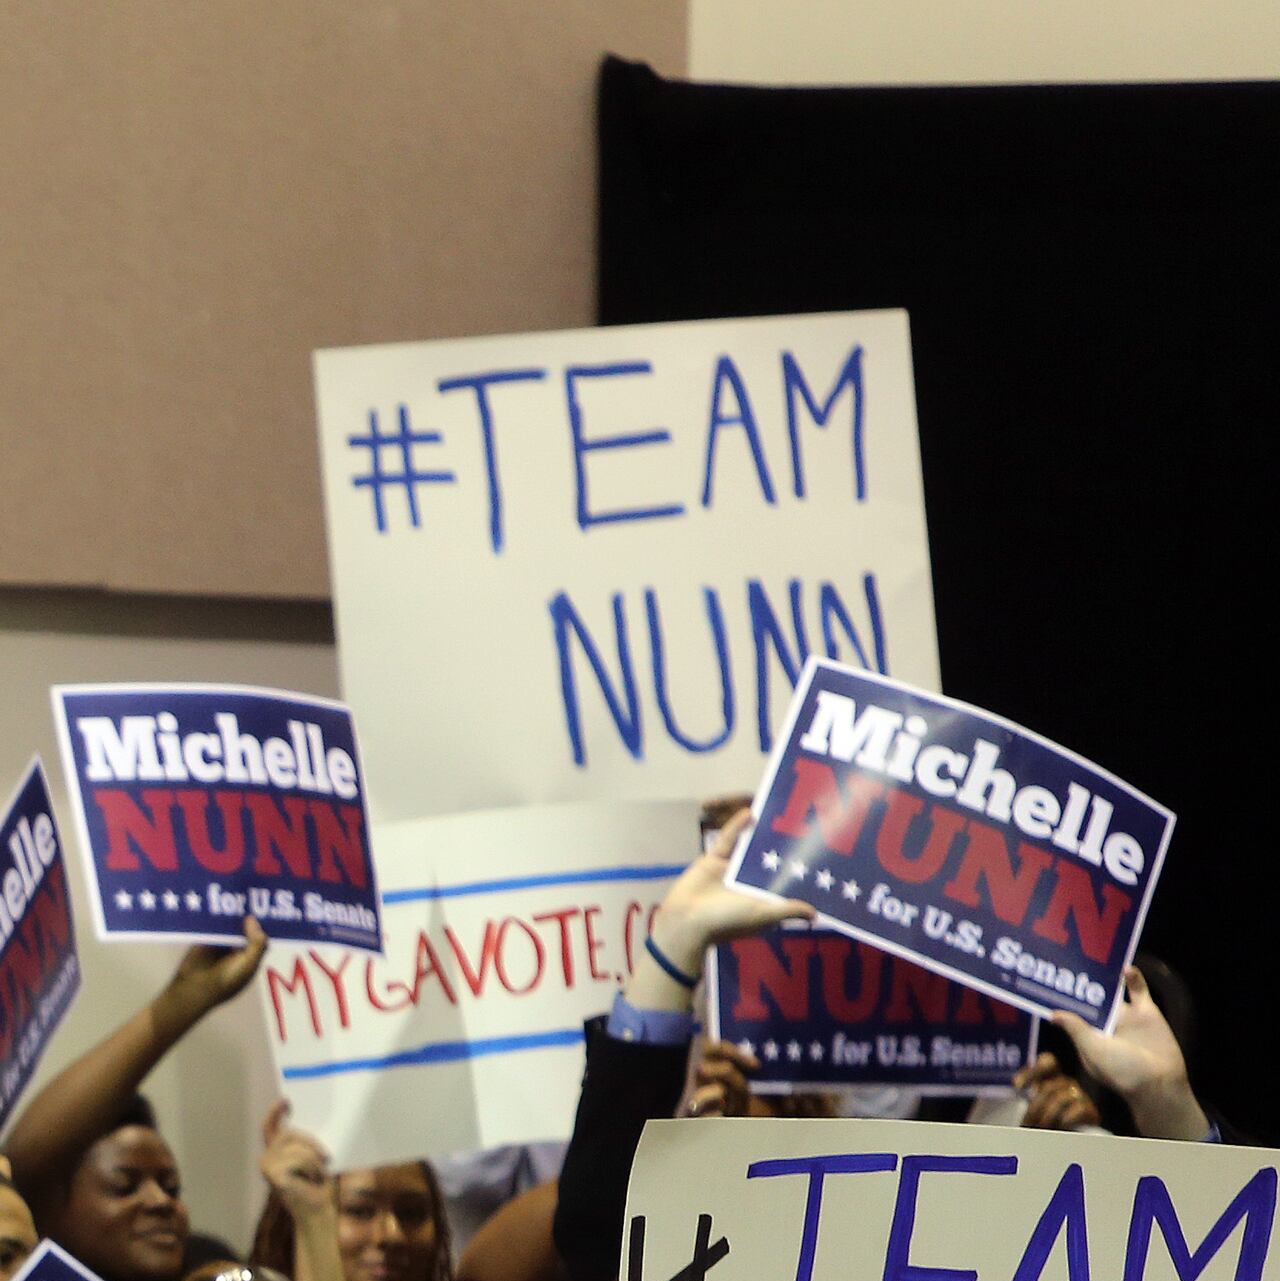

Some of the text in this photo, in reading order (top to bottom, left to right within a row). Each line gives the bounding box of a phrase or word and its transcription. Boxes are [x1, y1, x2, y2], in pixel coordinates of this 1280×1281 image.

[347, 344, 869, 554] #TEAM
[76, 711, 359, 800] Michelle
[799, 689, 1146, 887] Michelle
[94, 788, 368, 889] NUNN
[770, 756, 1134, 965] NUNN
[207, 882, 378, 932] for U.S. Senate
[867, 882, 919, 930] for
[923, 904, 986, 958] U.S.
[991, 936, 1107, 1007] Senate
[831, 1032, 1021, 1068] for U.S. Senate
